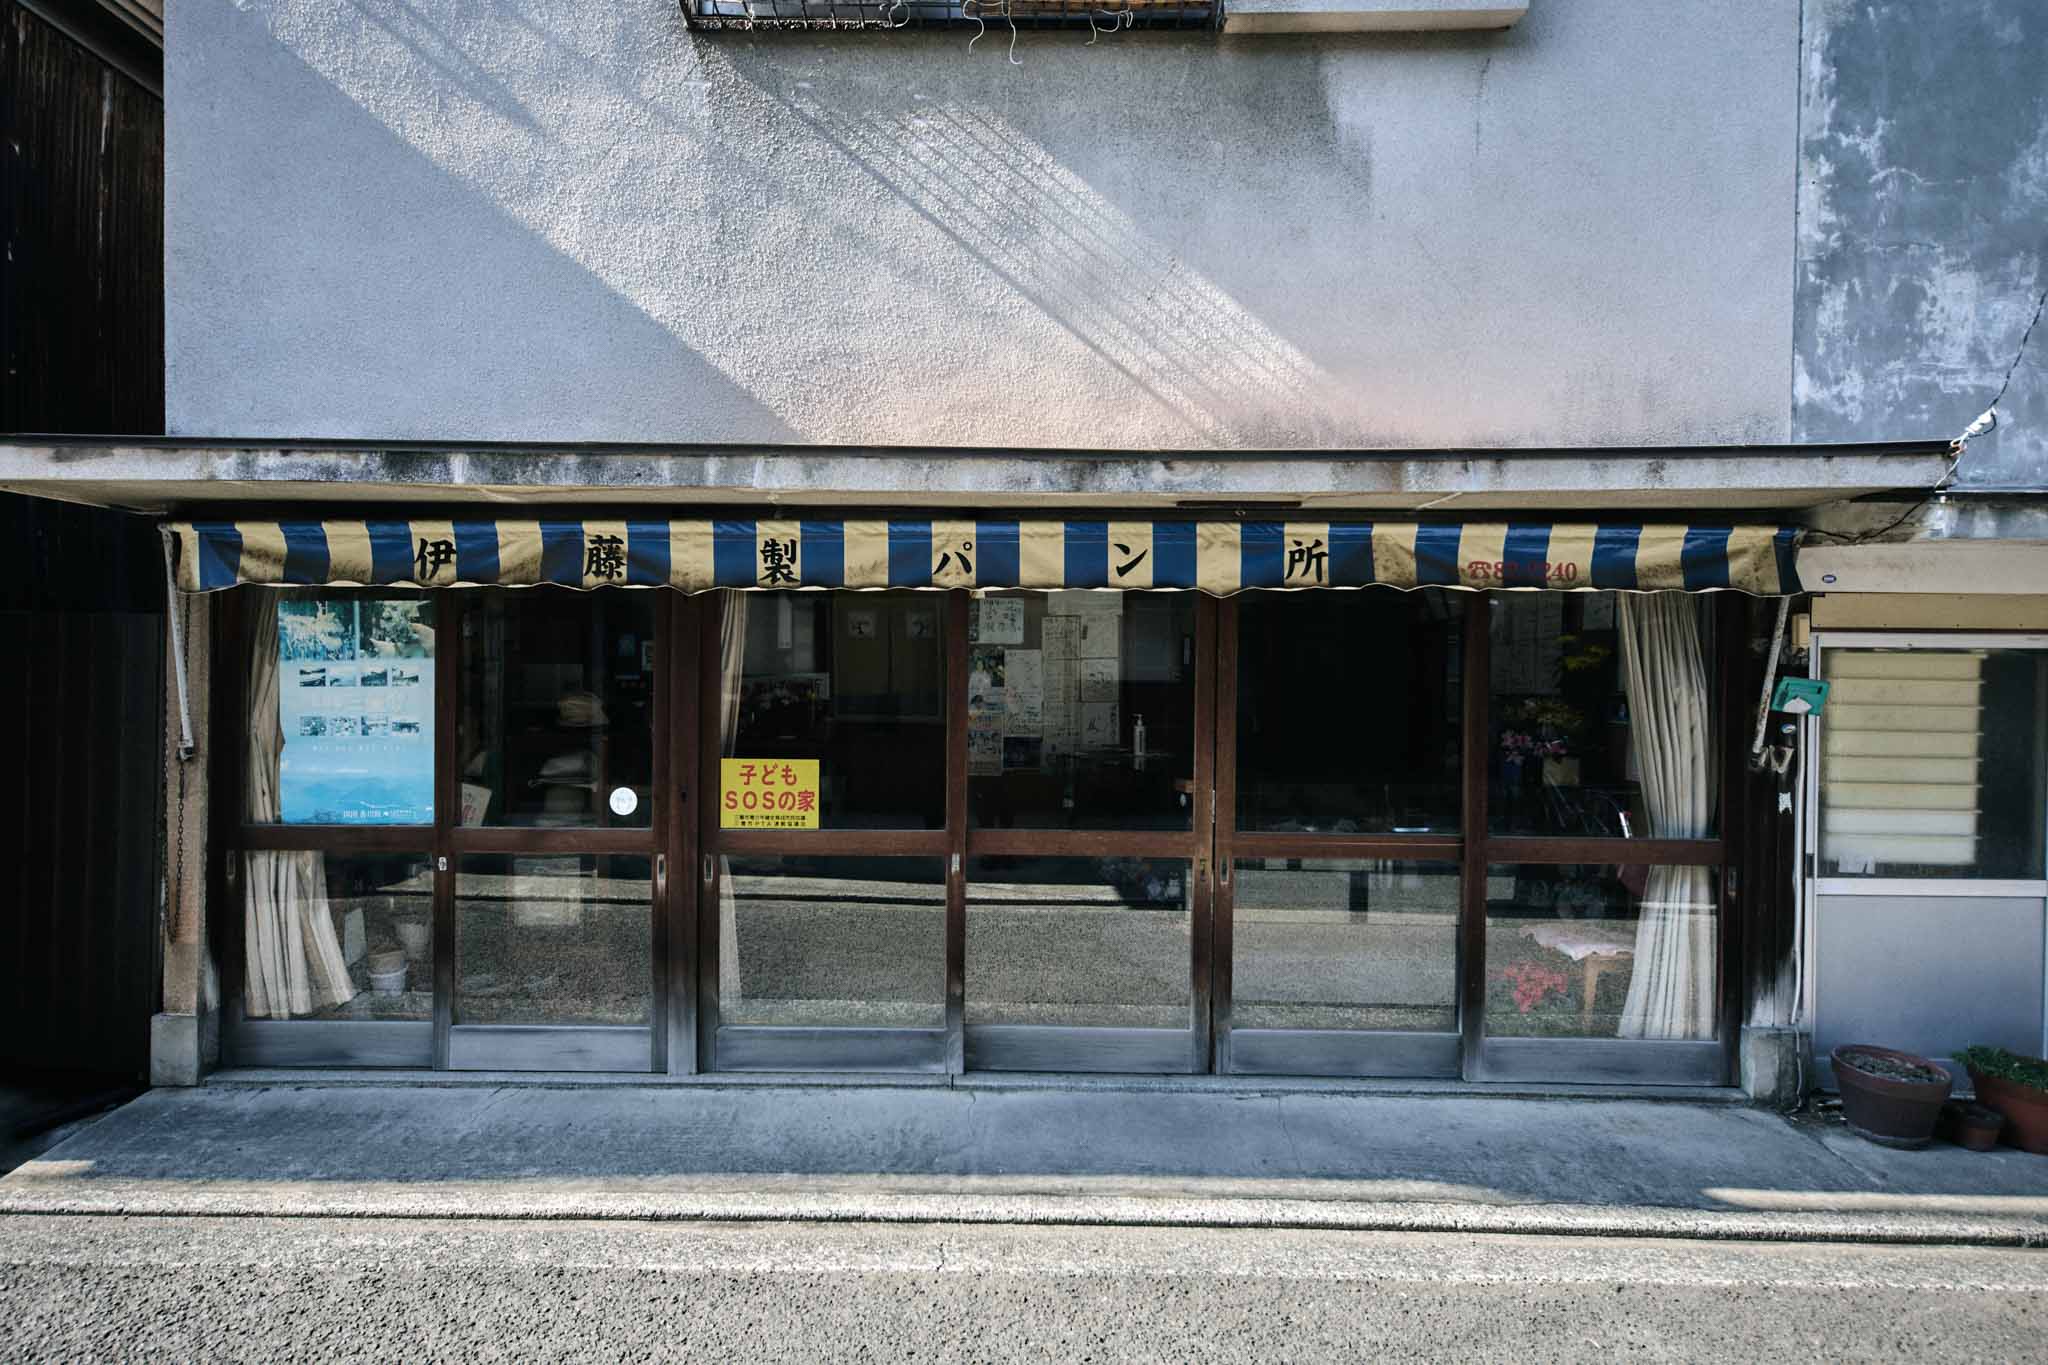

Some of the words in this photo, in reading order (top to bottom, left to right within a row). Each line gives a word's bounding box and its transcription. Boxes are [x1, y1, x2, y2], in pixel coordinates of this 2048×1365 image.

[414, 534, 1329, 584] 伊藤製パン所
[739, 763, 797, 785] 子ども
[725, 790, 815, 812] SOSの家
